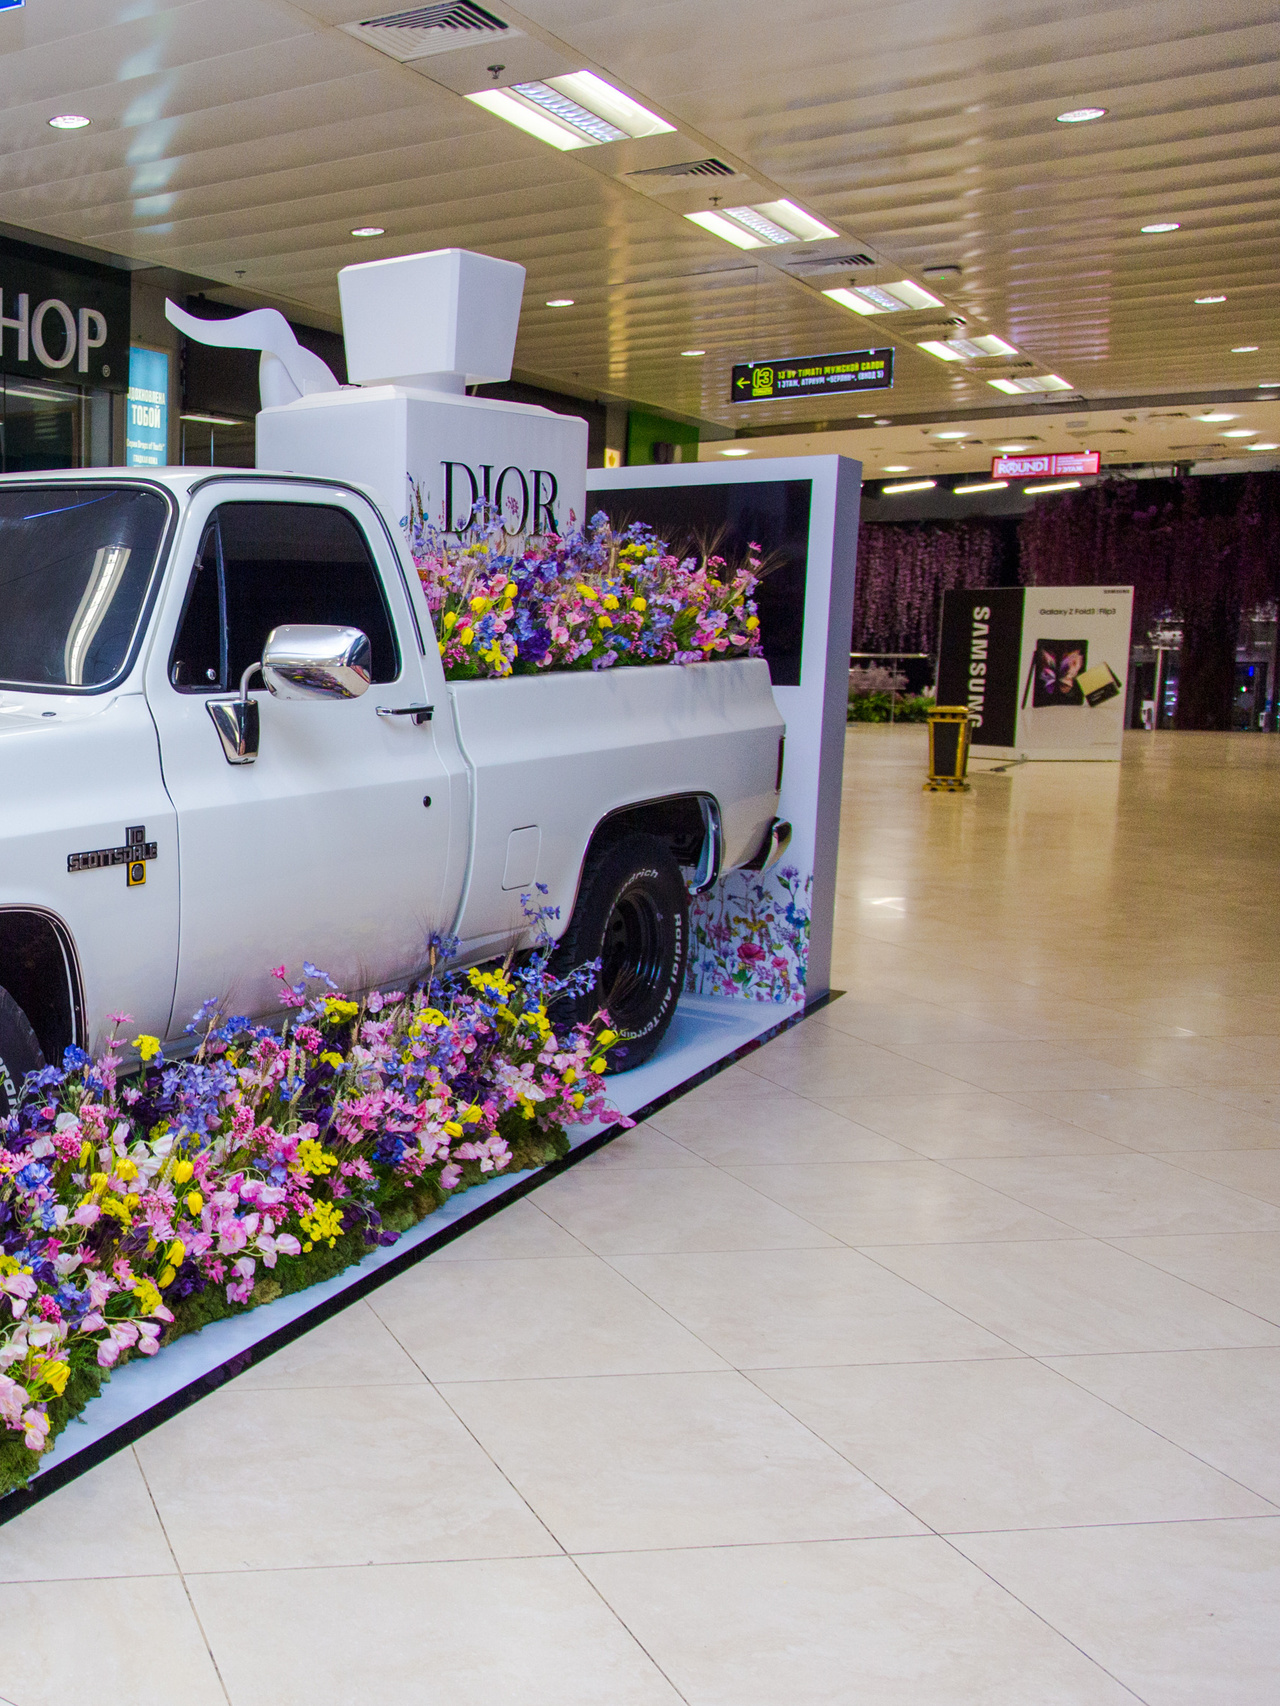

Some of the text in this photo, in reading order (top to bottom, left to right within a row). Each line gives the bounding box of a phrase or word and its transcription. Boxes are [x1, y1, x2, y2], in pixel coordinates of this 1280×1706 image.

[778, 370, 785, 379] 13
[824, 362, 859, 375] МУЖСКОЙ
[861, 360, 884, 371] САЛОН
[801, 376, 825, 386] АТРИУМ
[131, 404, 161, 428] ТОБОЙ
[998, 458, 1048, 474] ROUND1
[440, 460, 561, 538] DIOR
[1039, 608, 1067, 616] Galaxy
[968, 606, 991, 728] SAMSUNG
[67, 842, 157, 872] SCOTTSDALE
[672, 913, 683, 984] Radial
